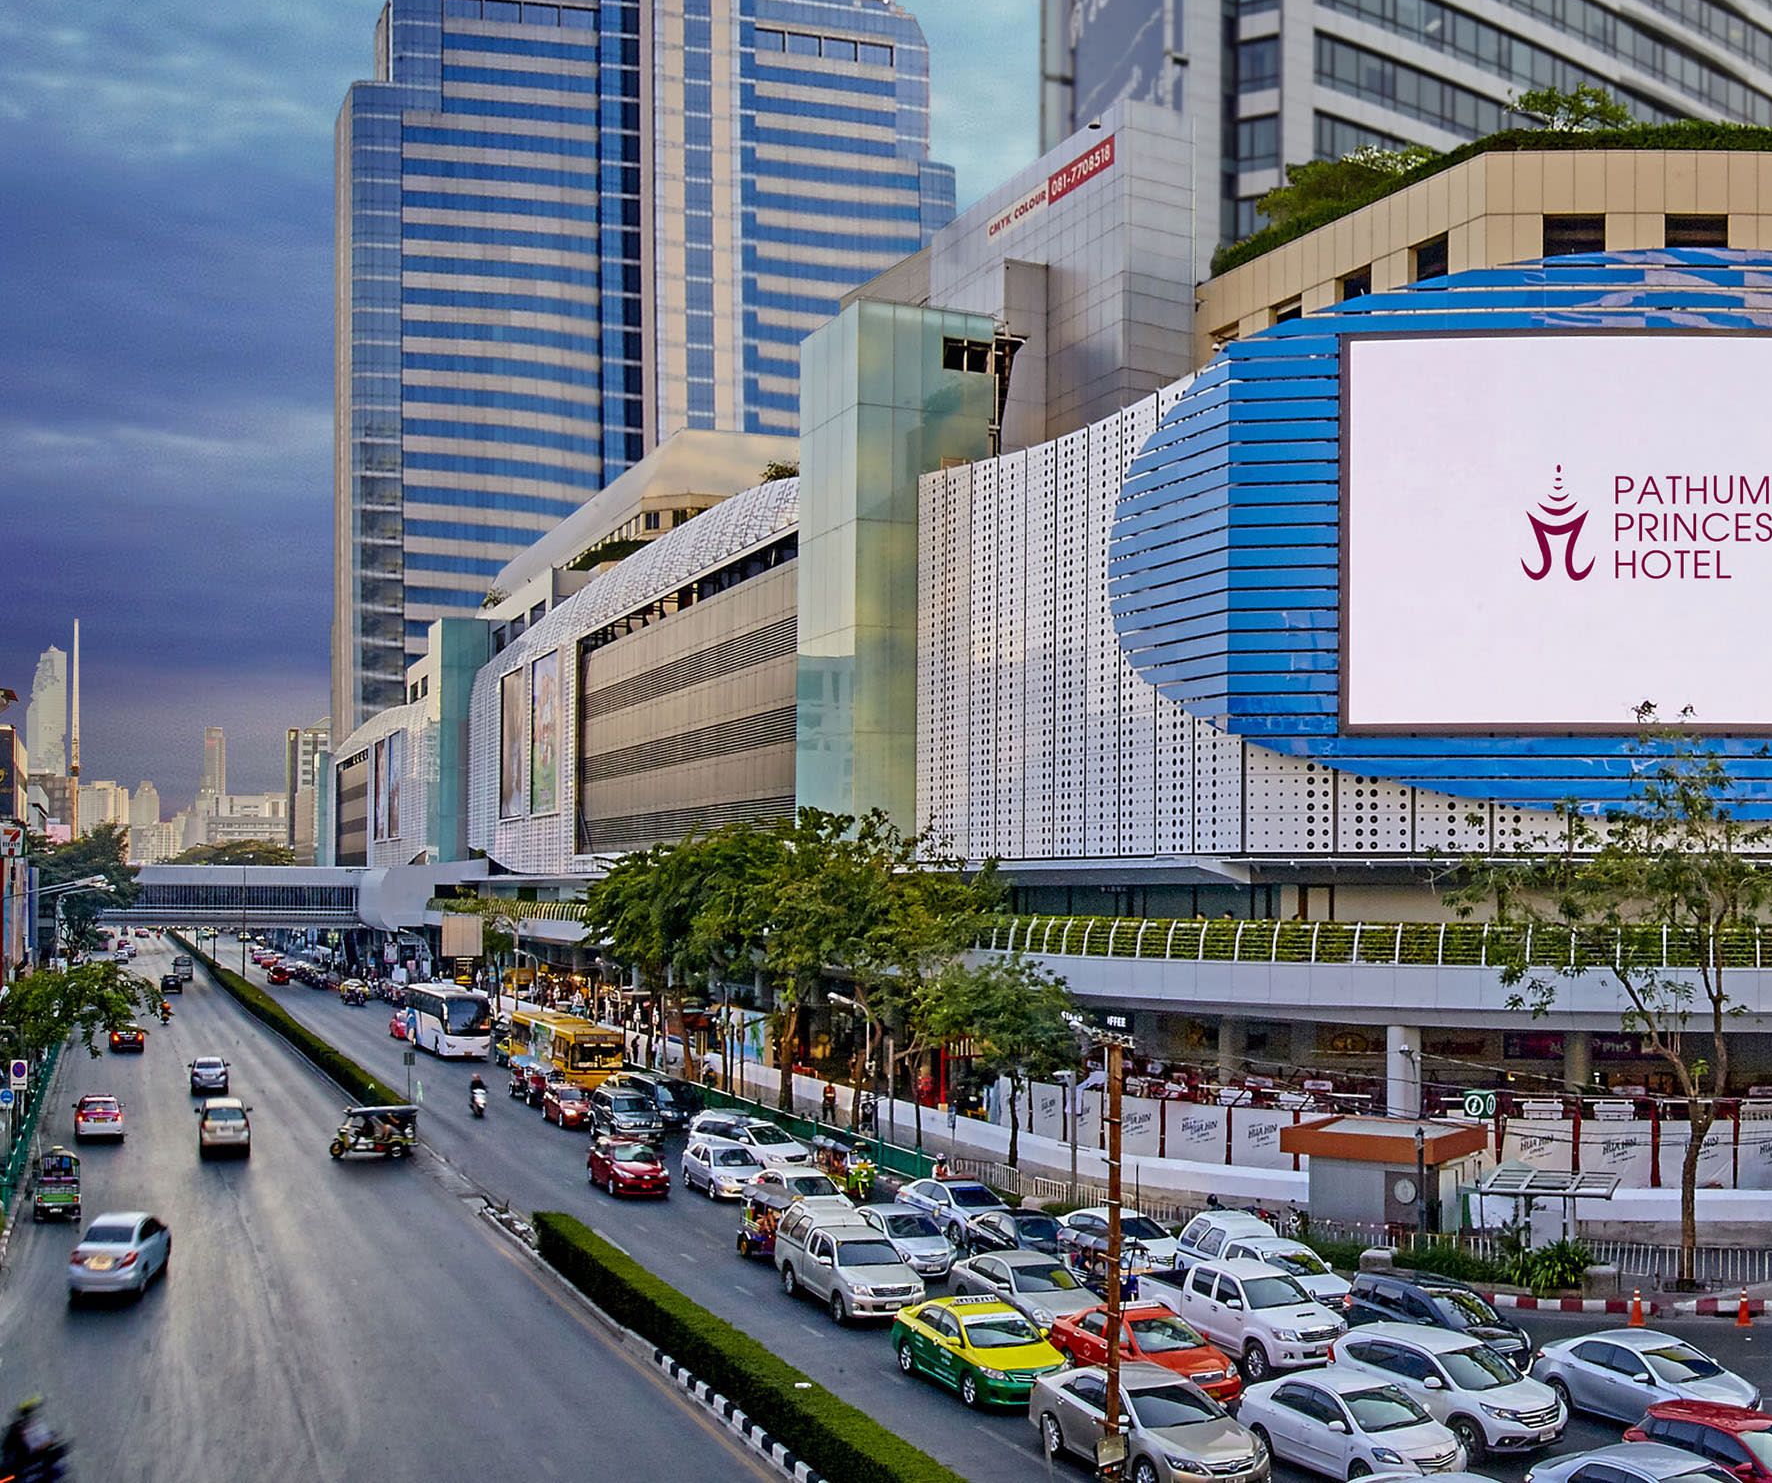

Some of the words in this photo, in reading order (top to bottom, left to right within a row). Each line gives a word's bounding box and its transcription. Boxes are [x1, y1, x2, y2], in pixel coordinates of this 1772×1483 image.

[1014, 190, 1047, 219] COLOUR
[1051, 144, 1111, 196] 081-7708518
[1614, 549, 1733, 579] HOTEL
